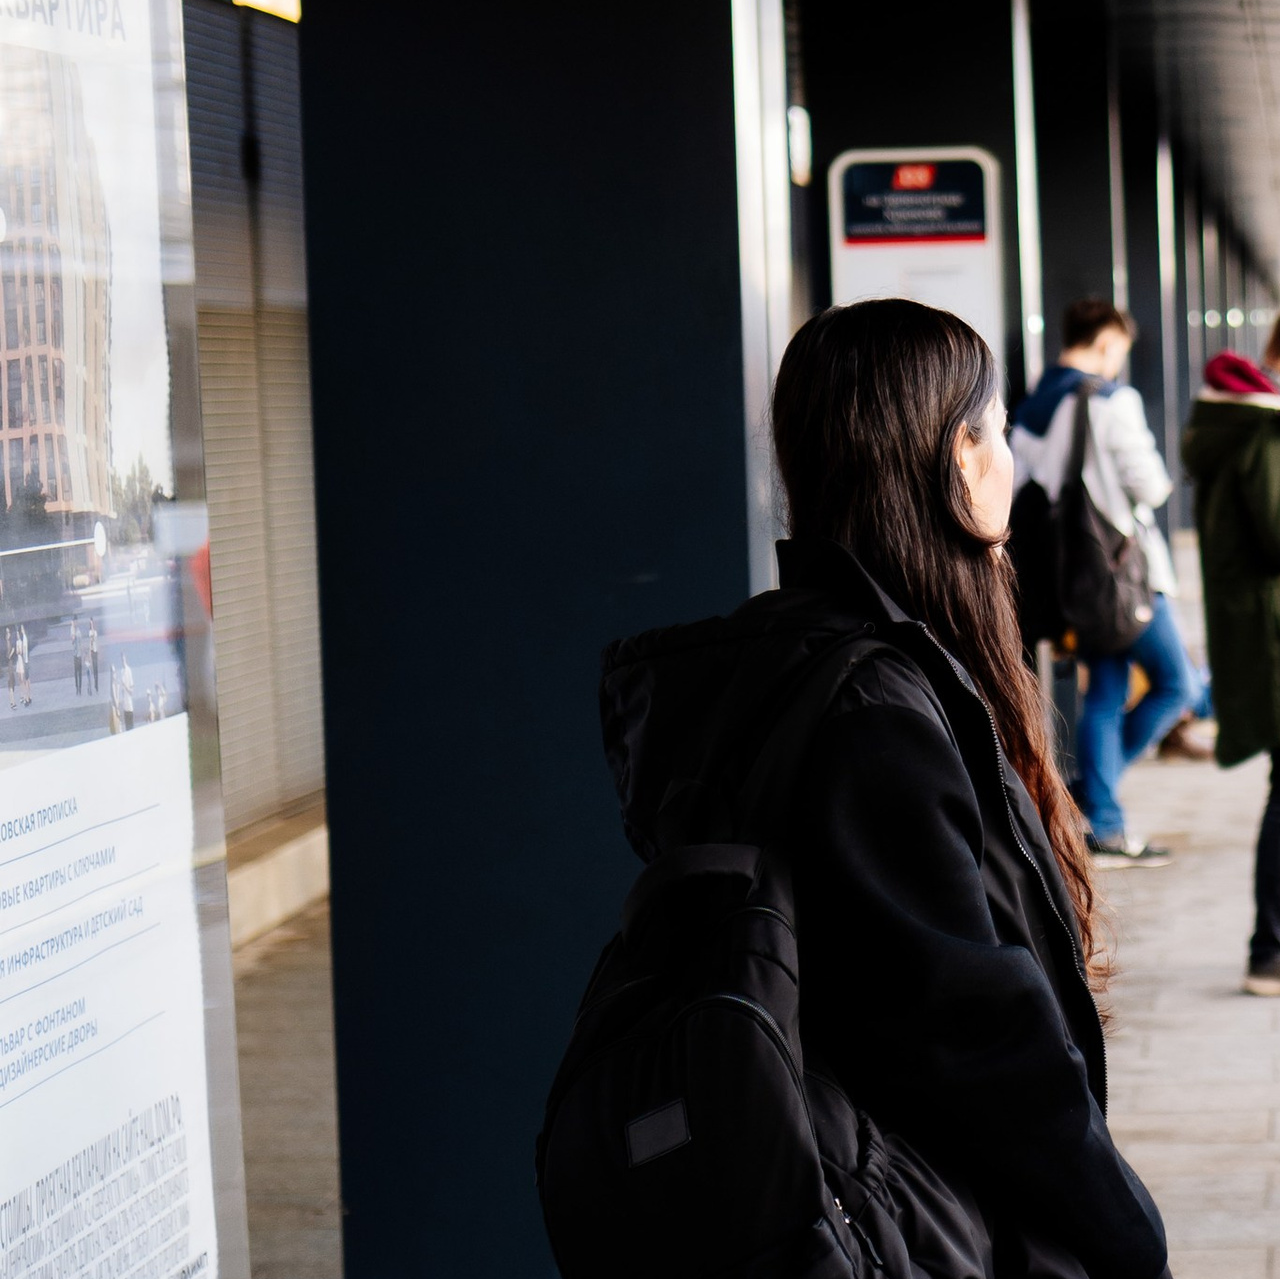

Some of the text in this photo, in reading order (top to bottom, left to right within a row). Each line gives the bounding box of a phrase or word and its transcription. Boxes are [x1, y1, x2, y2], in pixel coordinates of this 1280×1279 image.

[36, 797, 78, 830] ПРОПИСКА
[22, 865, 67, 902] КВАРТИРЫ
[67, 863, 72, 882] С
[73, 846, 116, 879] КЛЮЧАМИ
[7, 924, 84, 975] ИНФРАСТРУКТУРА
[84, 919, 90, 939] И
[91, 898, 127, 939] ДЕТСКИЙ
[127, 895, 144, 918] САД
[27, 1023, 33, 1041] С
[34, 997, 86, 1037] ФОНТАНОМ
[66, 1018, 98, 1054] ДВОРЫ
